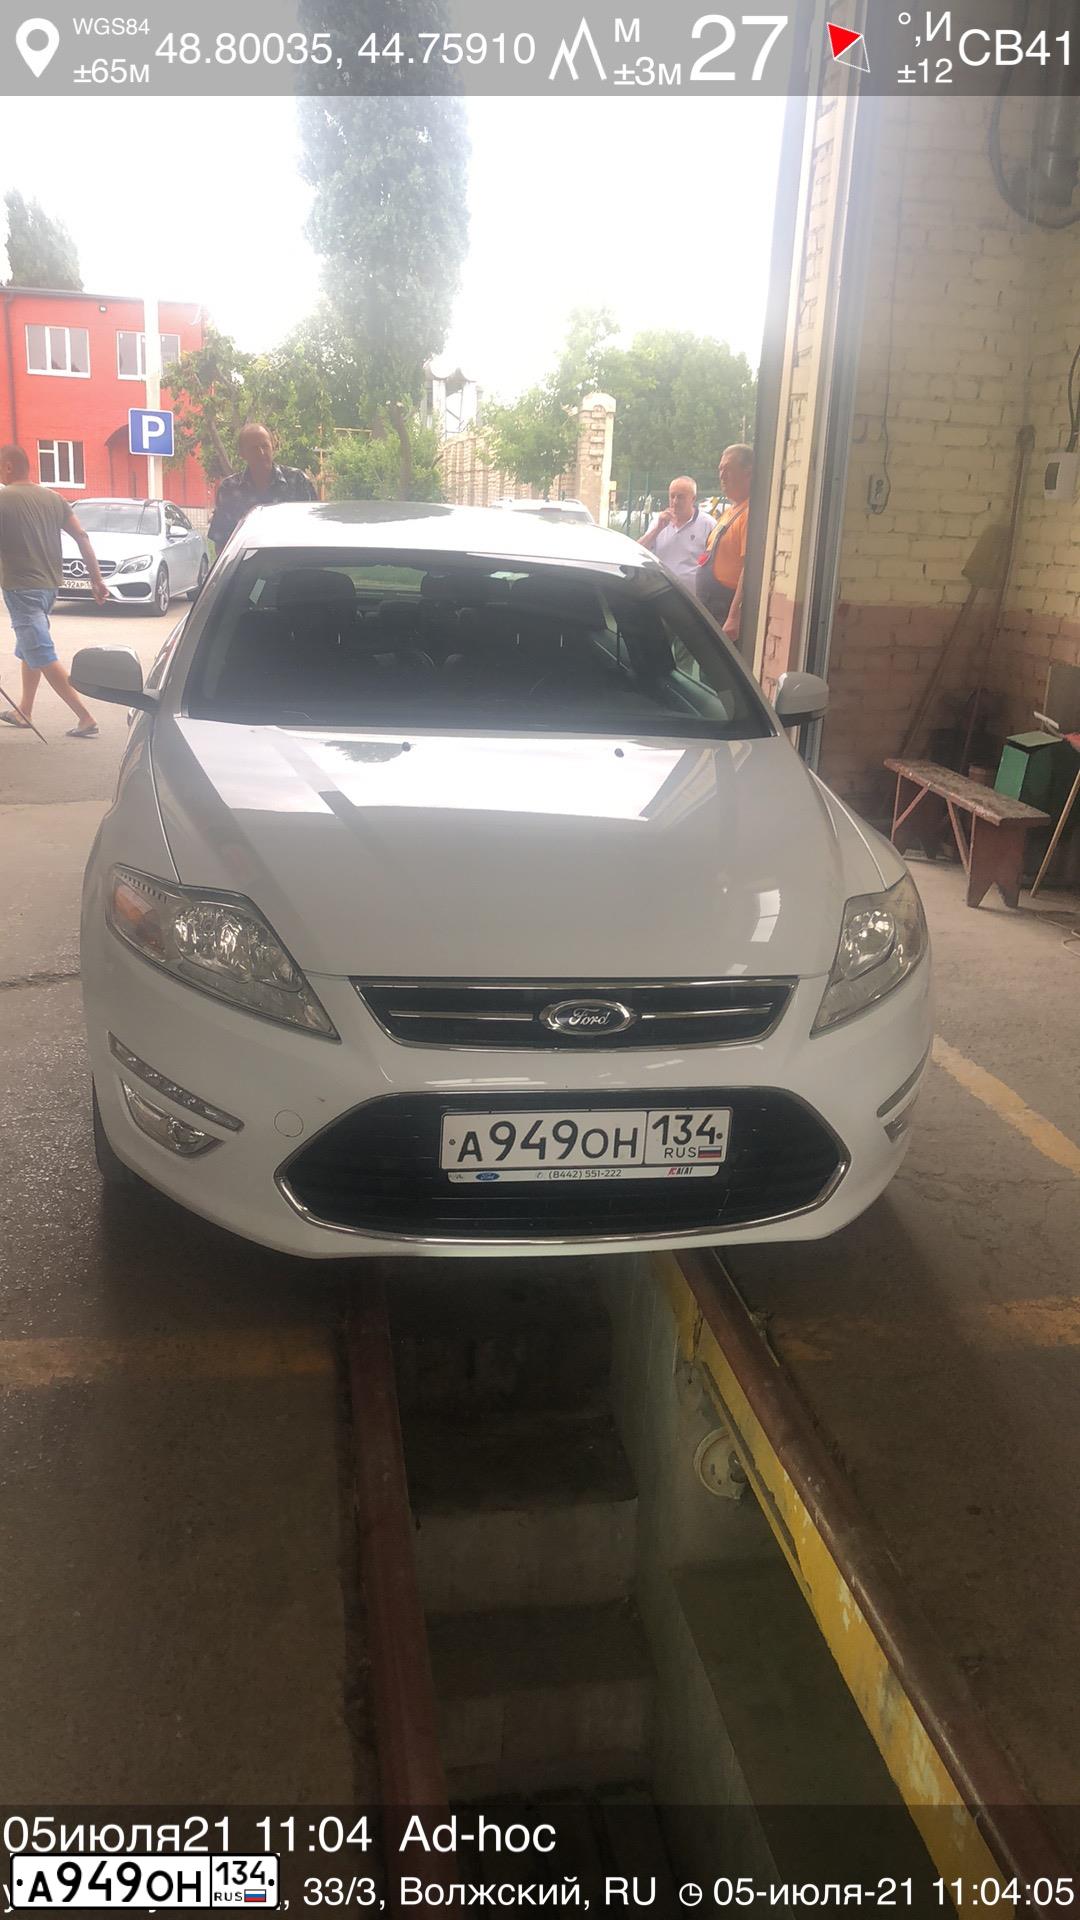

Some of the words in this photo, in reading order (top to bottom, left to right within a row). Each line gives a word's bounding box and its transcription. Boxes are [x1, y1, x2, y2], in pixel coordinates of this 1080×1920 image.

[141, 414, 166, 449] P
[568, 1006, 611, 1026] Ford
[456, 1119, 639, 1163] А949ОН
[652, 1113, 717, 1146] 134
[664, 1147, 697, 1159] RUS
[548, 1170, 583, 1180] (8442)
[585, 1169, 622, 1179] 551-222
